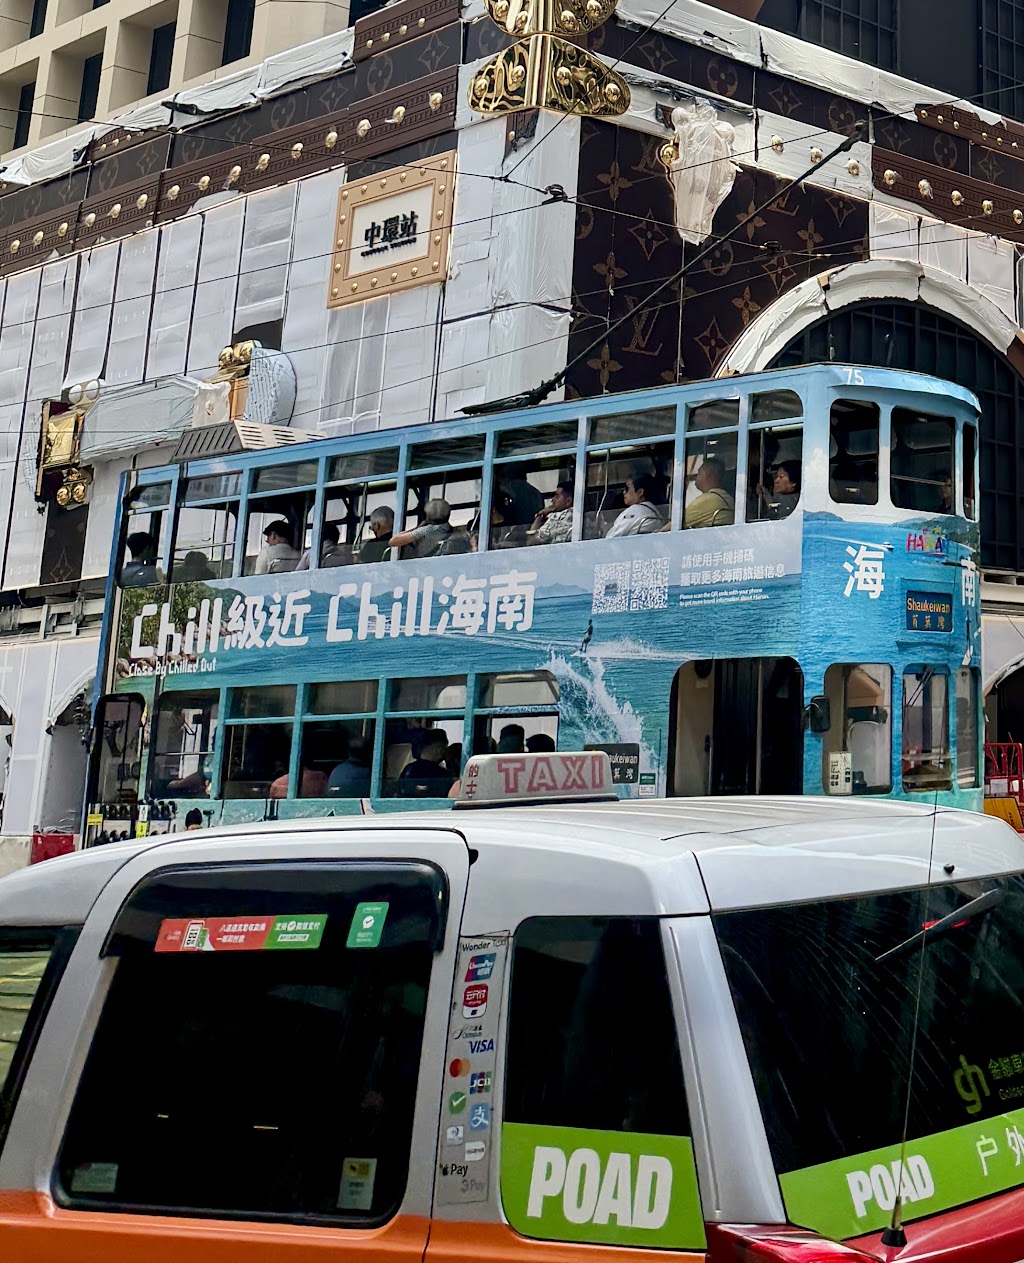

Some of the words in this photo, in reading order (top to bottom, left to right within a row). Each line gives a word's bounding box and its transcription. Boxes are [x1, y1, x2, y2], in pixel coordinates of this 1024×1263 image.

[364, 211, 418, 248] 中環站
[843, 368, 864, 385] 75
[842, 545, 886, 600] 海
[960, 557, 977, 608] 南
[131, 589, 312, 659] Chill級近
[327, 570, 538, 643] Chill海南
[906, 597, 950, 614] Shaukeiwan
[129, 663, 153, 677] Close
[155, 661, 167, 680] By
[168, 657, 199, 674] Chilled
[200, 657, 217, 672] Out
[608, 753, 638, 764] aukeiwan
[465, 763, 480, 799] 的士
[497, 755, 605, 794] TAXI
[462, 942, 491, 952] Wonder
[469, 1039, 494, 1054] VISA
[470, 1077, 491, 1088] JCB
[450, 1163, 469, 1177] Pay
[527, 1145, 673, 1230] POAD
[845, 1154, 936, 1219] POAD
